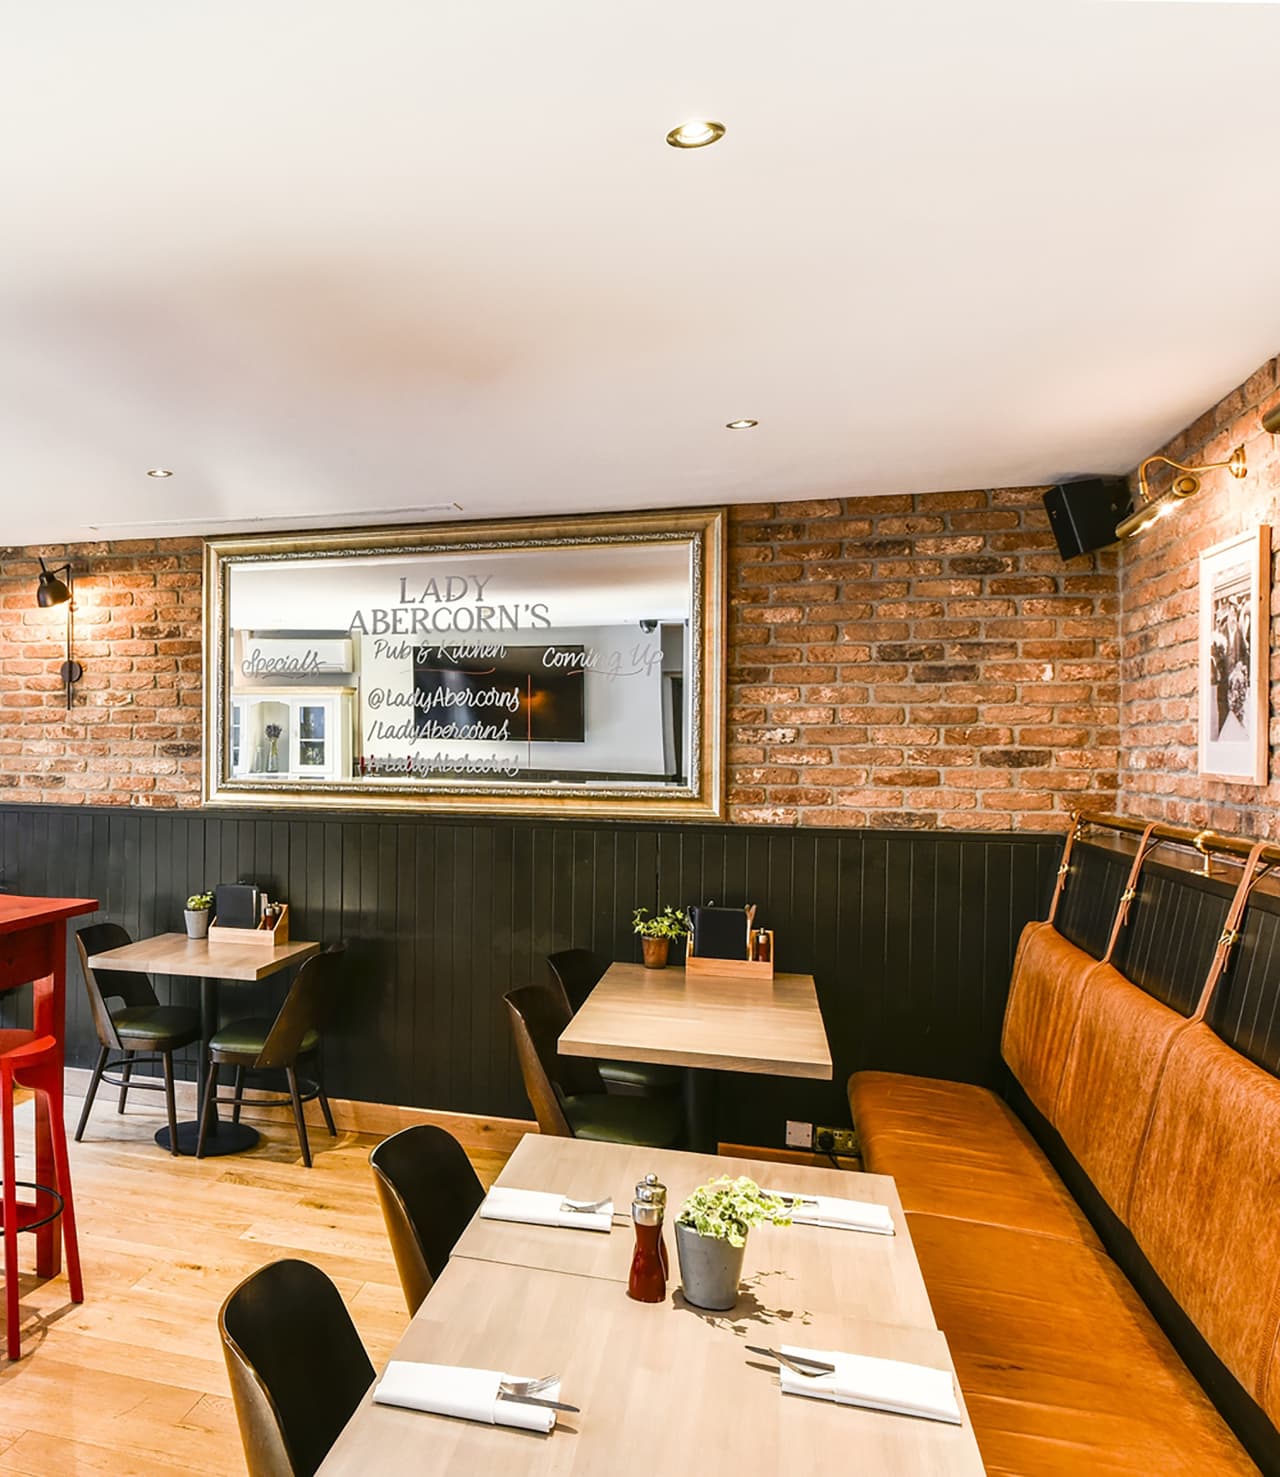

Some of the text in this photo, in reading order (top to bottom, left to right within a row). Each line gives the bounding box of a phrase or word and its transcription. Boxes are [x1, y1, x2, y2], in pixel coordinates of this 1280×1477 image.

[398, 574, 493, 604] LADY
[348, 603, 552, 637] ABERCORN'S
[241, 647, 327, 679] Specials
[373, 636, 508, 665] Pub & Kitchen
[542, 643, 664, 683] Coming Up
[367, 685, 520, 714] @LadyAbercorns
[367, 718, 511, 746] /LadyAbercorns
